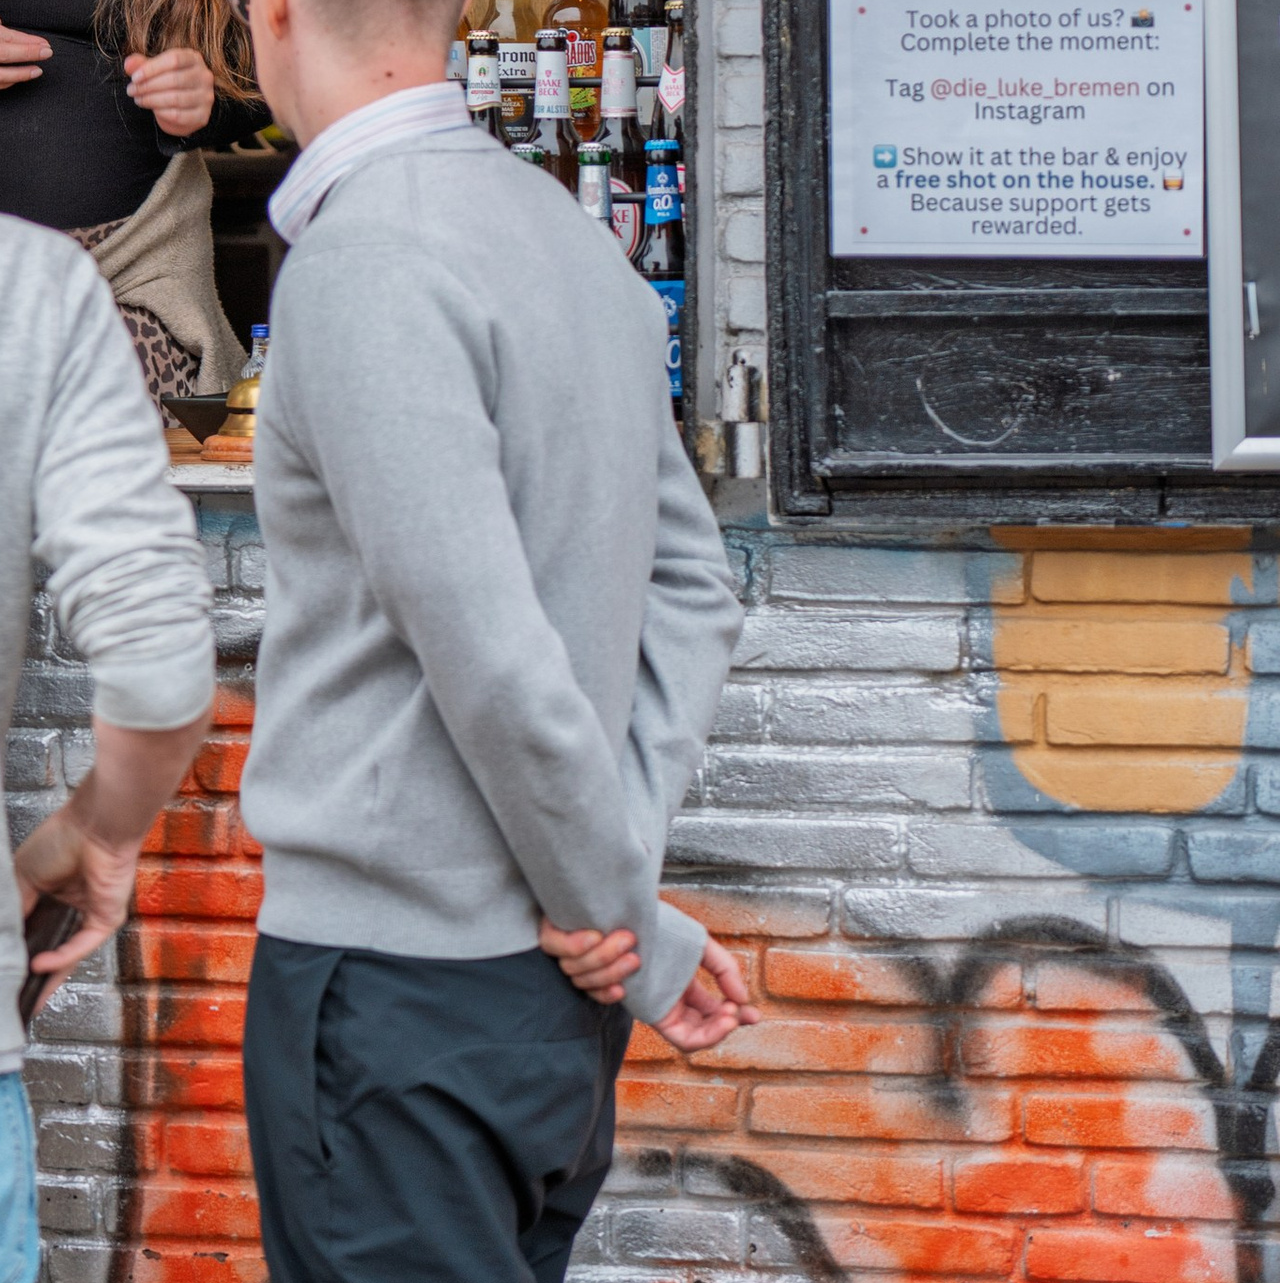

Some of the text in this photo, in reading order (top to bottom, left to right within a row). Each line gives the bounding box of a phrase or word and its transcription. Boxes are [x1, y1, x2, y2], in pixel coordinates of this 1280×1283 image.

[906, 8, 1124, 32] Took photo of us?
[498, 51, 536, 63] rona
[538, 88, 560, 96] BECK
[885, 78, 1174, 102] Tag @die_luke_bremen on
[976, 102, 1085, 125] Instagram
